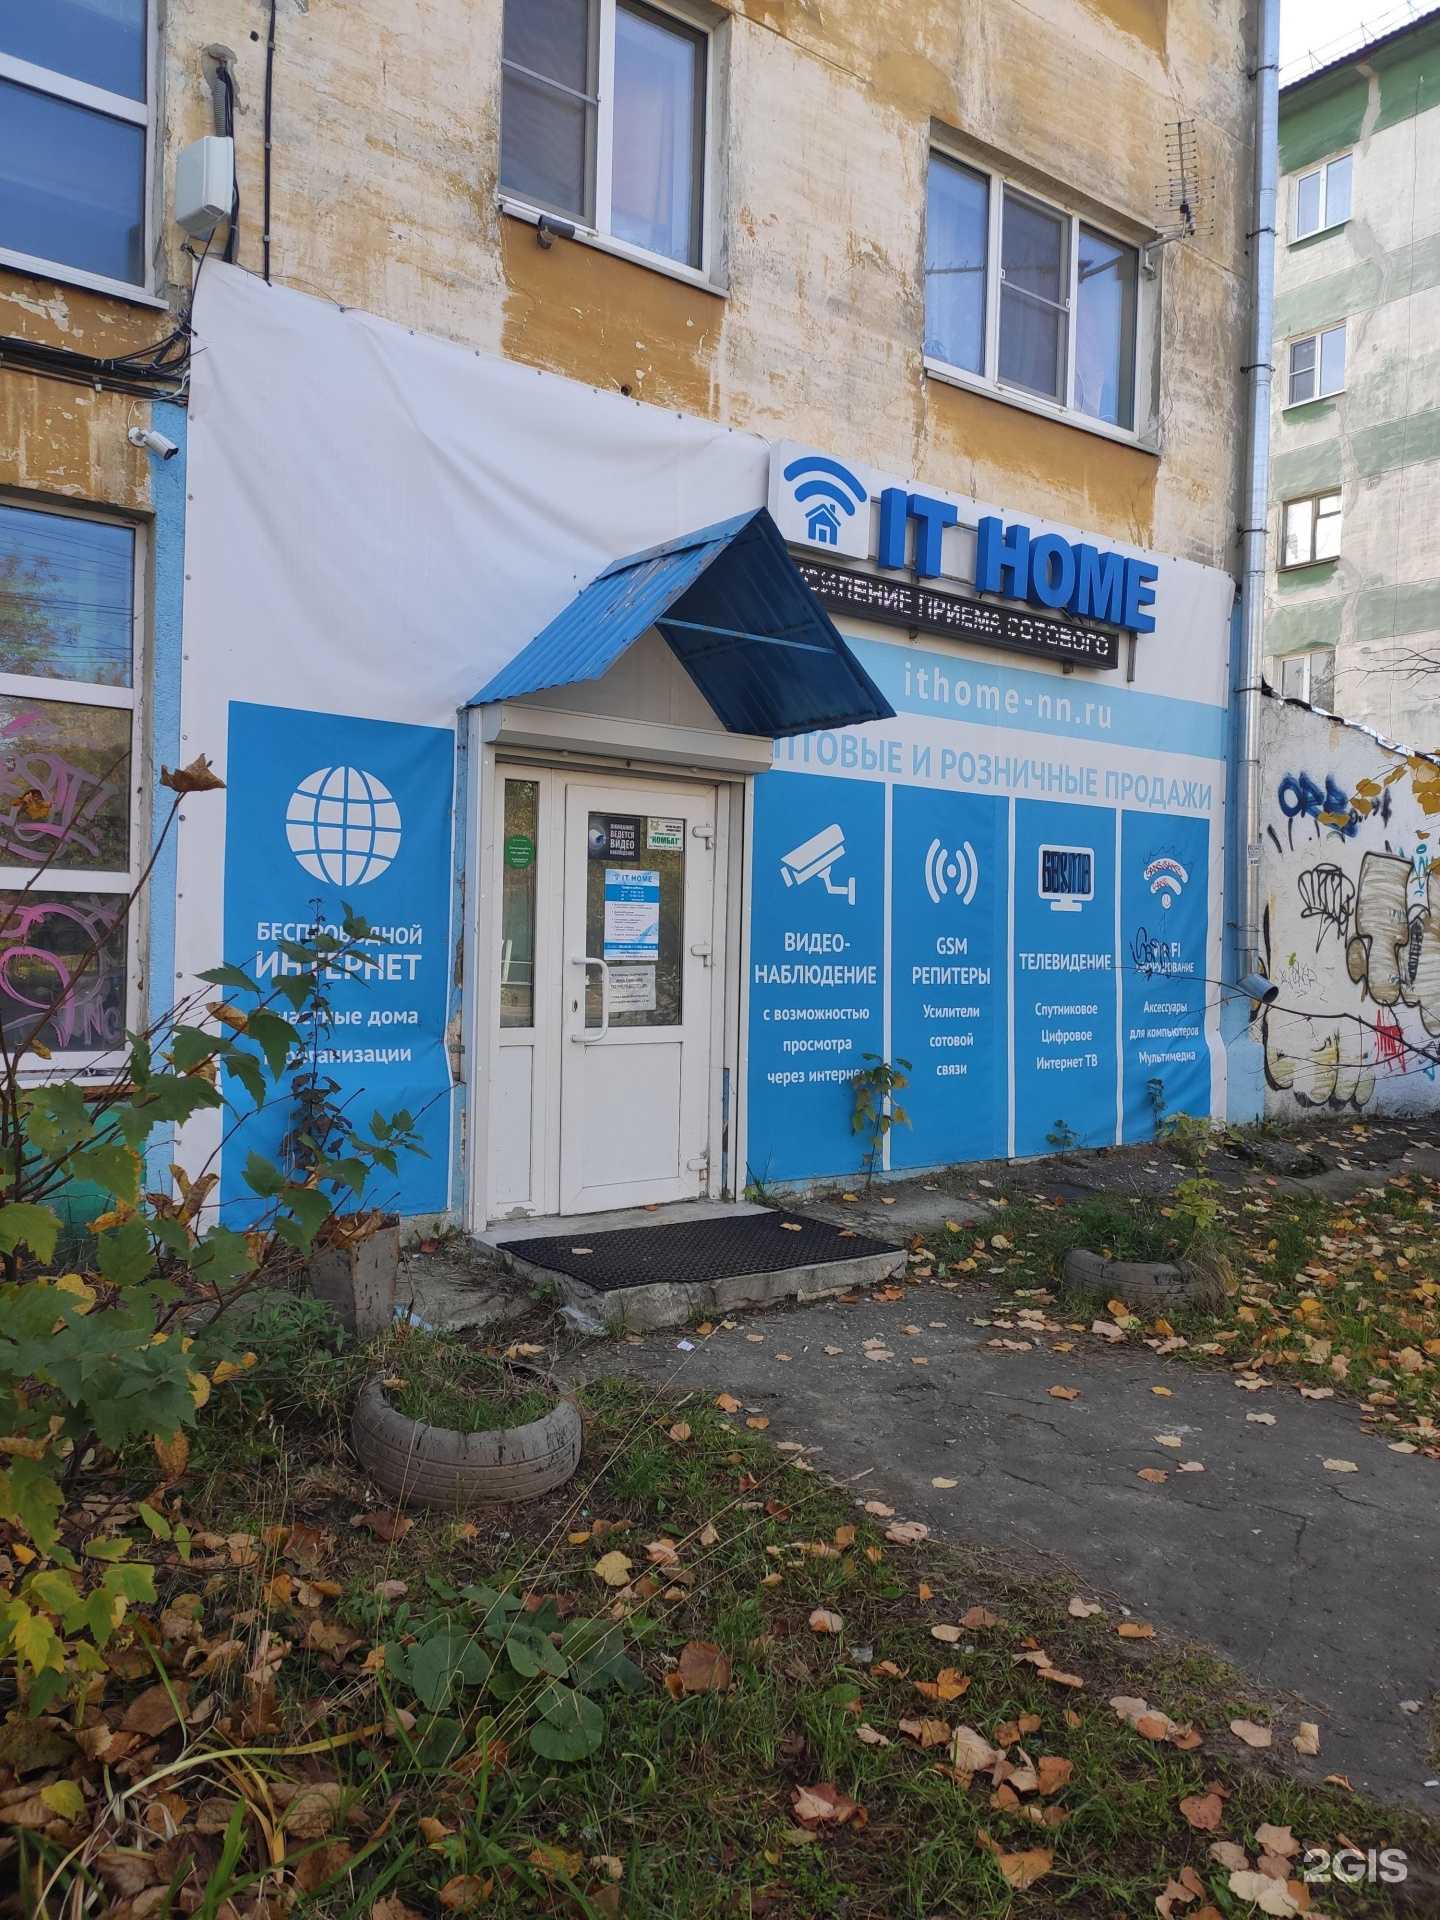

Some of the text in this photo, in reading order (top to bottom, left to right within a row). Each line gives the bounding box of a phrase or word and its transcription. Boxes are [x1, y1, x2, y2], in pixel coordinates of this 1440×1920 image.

[879, 487, 1158, 633] IT HOME
[1007, 617, 1109, 656] СОТОВОГО
[904, 662, 1112, 729] ithome-nn.ru
[774, 731, 1212, 810] ПТОВЫЕ И РОЗНИЧНЫЕ ПРОДАЖИ
[610, 839, 635, 850] ВИДЕО
[257, 922, 423, 946] БЕСПРОВДНОЙ
[783, 931, 851, 954] ВИДЕО-
[936, 936, 968, 956] GSM
[1019, 952, 1112, 973] ТЕЛЕВИДЕНИЕ
[754, 963, 877, 987] НАБЛЮДЕНИЕ
[912, 965, 991, 986] РЕПИТЕРЫ
[763, 1005, 870, 1022] с возможностью
[923, 1003, 980, 1019] Усилители
[1035, 1002, 1098, 1019] Спутниковое
[1143, 1000, 1188, 1015] Аксессуары
[367, 1009, 419, 1027] дома
[929, 1031, 974, 1048] сотовой
[1041, 1028, 1093, 1046] Цифровое
[1129, 1026, 1199, 1040] для компьютеров
[783, 1036, 853, 1054] просмотра
[1036, 1054, 1098, 1070] Интернет ТВ
[1138, 1050, 1196, 1066] Мультимедиа
[767, 1067, 865, 1087] через интерне
[936, 1062, 967, 1077] связи
